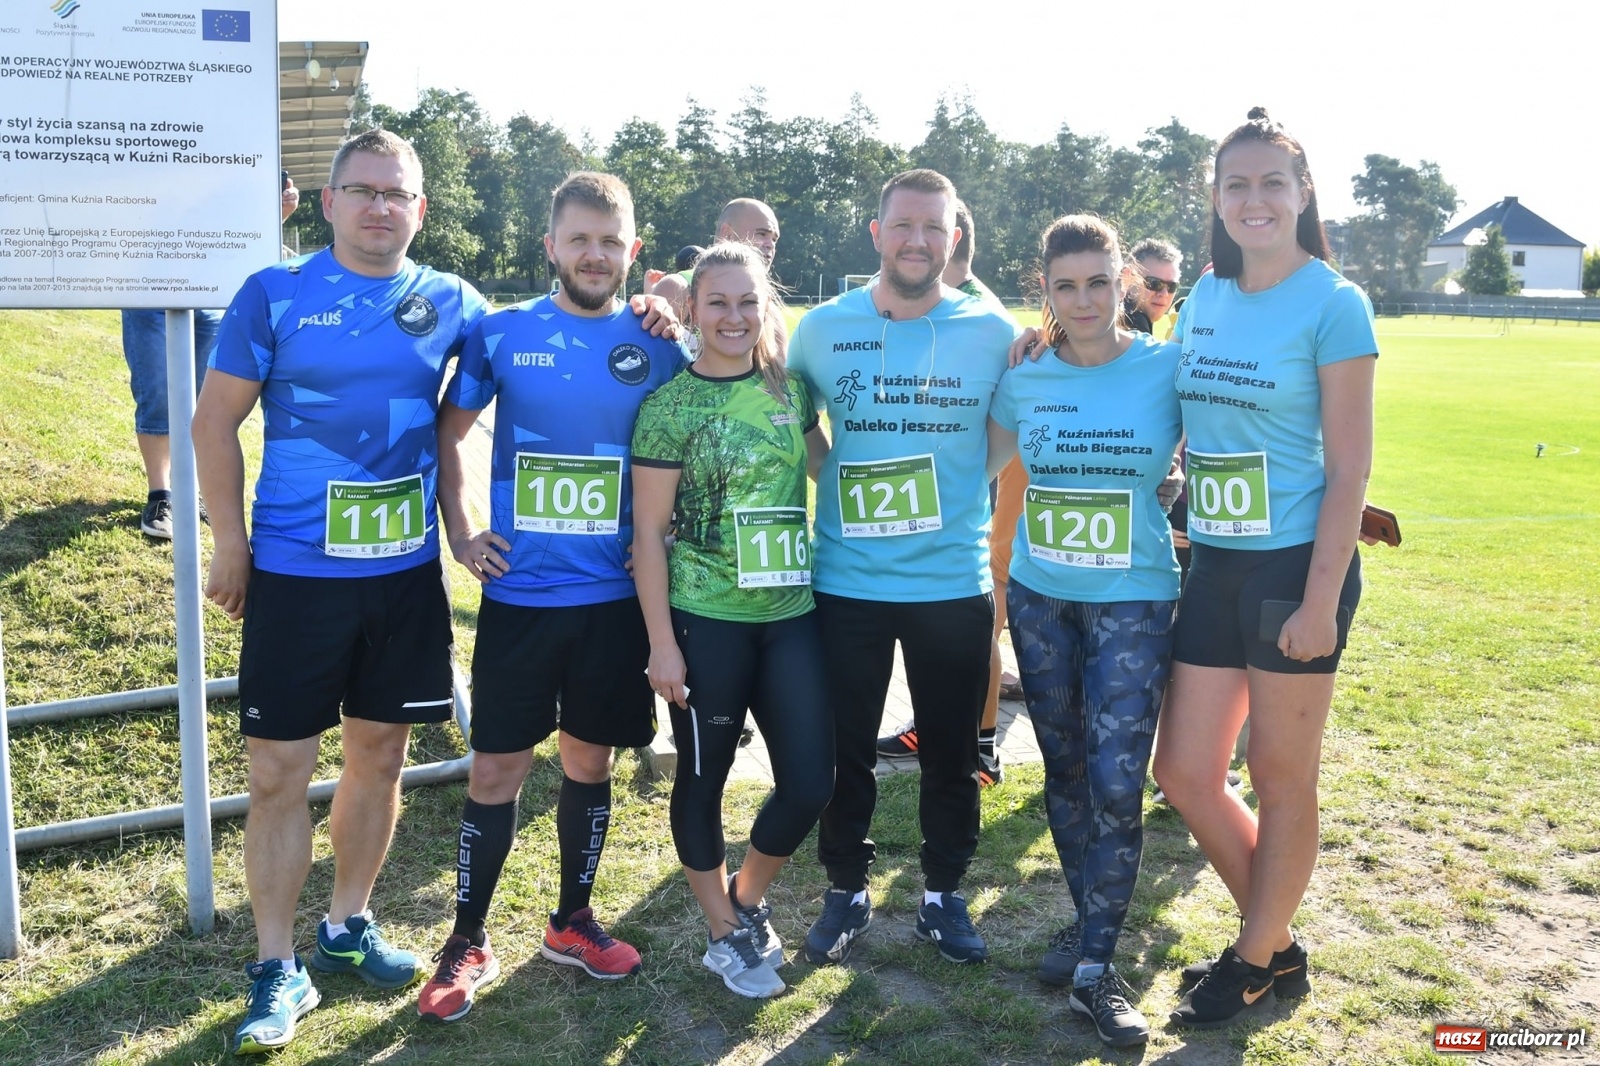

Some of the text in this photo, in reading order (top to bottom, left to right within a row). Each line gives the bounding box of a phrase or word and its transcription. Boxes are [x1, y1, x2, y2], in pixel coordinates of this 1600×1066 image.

[13, 56, 91, 68] OPERACYJNY
[95, 59, 186, 71] WOJEWÓDZTWA
[188, 61, 252, 74] ŚLĄSKIEGO
[65, 71, 81, 80] NA
[85, 71, 130, 81] REALNE
[133, 73, 193, 83] POTRZEBY
[7, 117, 204, 133] styl życia szansą na zdrowie
[34, 133, 111, 147] kompleksu
[115, 136, 197, 150] sportowego
[14, 149, 110, 164] towarzyszącą
[114, 153, 125, 162] w
[129, 151, 168, 162] Kuźni
[38, 194, 69, 203] Gmina
[71, 195, 103, 204] Kuźnia
[105, 196, 157, 205] Raciborska
[23, 227, 45, 237] Unię
[48, 228, 100, 238] Europejską
[110, 228, 175, 239] Europejskiego
[177, 229, 221, 238] Funduszu
[224, 230, 261, 240] Rozwoju
[5, 238, 246, 250] Regionalnego Programu Operacyjnego Województwa
[14, 249, 64, 258] 2007-2013
[89, 250, 120, 260] Gminę
[122, 250, 154, 259] Kuźnia
[156, 251, 207, 260] Raciborska
[56, 276, 104, 284] Regionalnego
[141, 277, 189, 285] Operacyjnego
[1191, 326, 1214, 336] ANETA
[833, 341, 883, 353] MARCIN
[513, 352, 555, 367] KOTEK
[1196, 355, 1259, 371] Kuźniański
[873, 374, 961, 389] Kuźniański
[1190, 369, 1276, 390] Klub Biegacza
[874, 393, 979, 408] Klub Biegacza
[1176, 389, 1207, 402] aleko
[1034, 405, 1078, 413] DANUSIA
[845, 419, 898, 432] Daleko
[1057, 429, 1135, 439] Kuźniański
[1056, 443, 1152, 455] Klub Biegacza
[522, 459, 530, 469] V
[1030, 464, 1078, 475] Daleko
[842, 468, 847, 478] V
[334, 488, 343, 498] V
[528, 476, 606, 516] 106
[849, 479, 920, 519] 121
[1029, 491, 1037, 502] V
[1190, 474, 1251, 516] 100
[341, 499, 410, 540] 111
[741, 515, 749, 525] V
[1037, 509, 1116, 550] 120
[750, 530, 806, 567] 116
